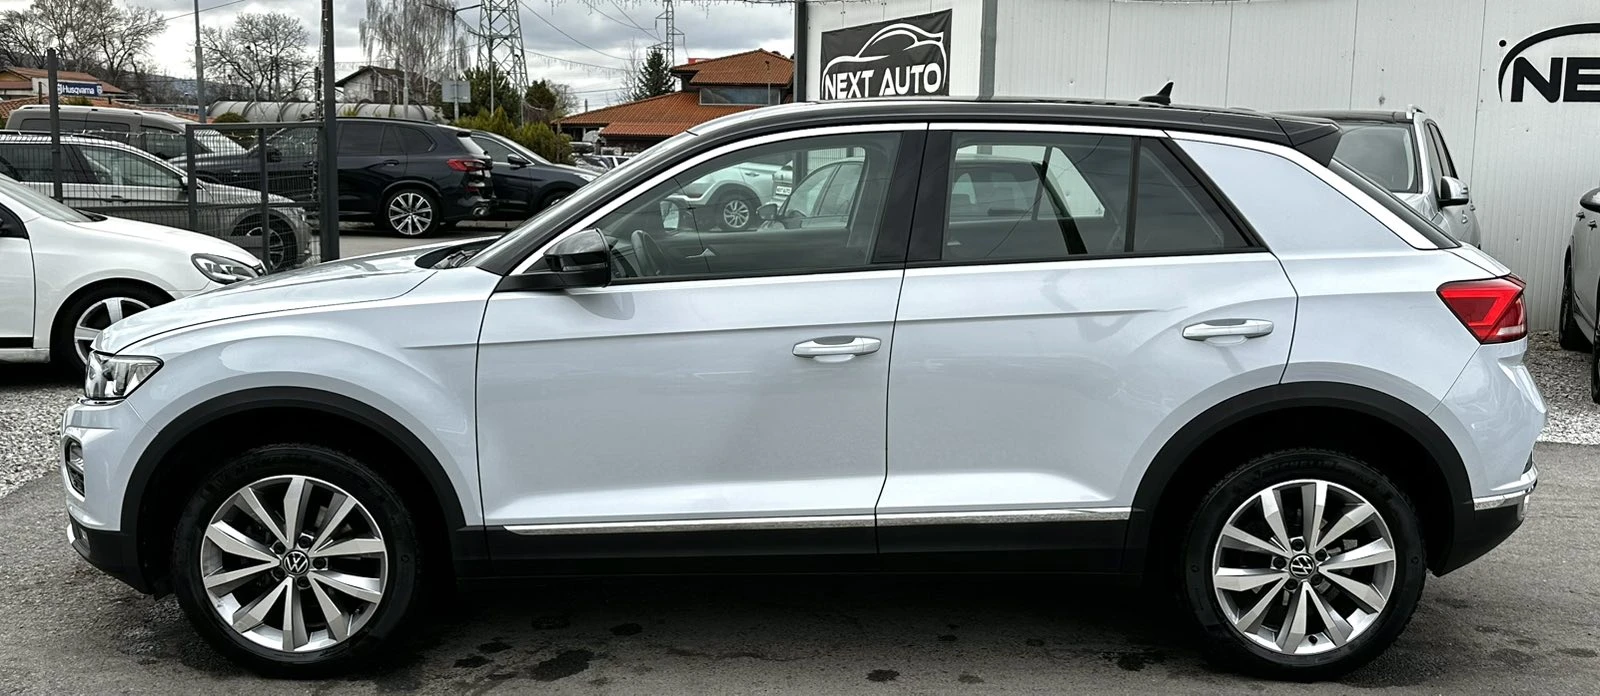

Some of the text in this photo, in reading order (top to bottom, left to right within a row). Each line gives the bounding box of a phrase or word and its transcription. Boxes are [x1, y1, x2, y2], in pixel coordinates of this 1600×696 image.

[62, 84, 95, 94] Husqvarna
[825, 62, 942, 100] NEXT AUTO
